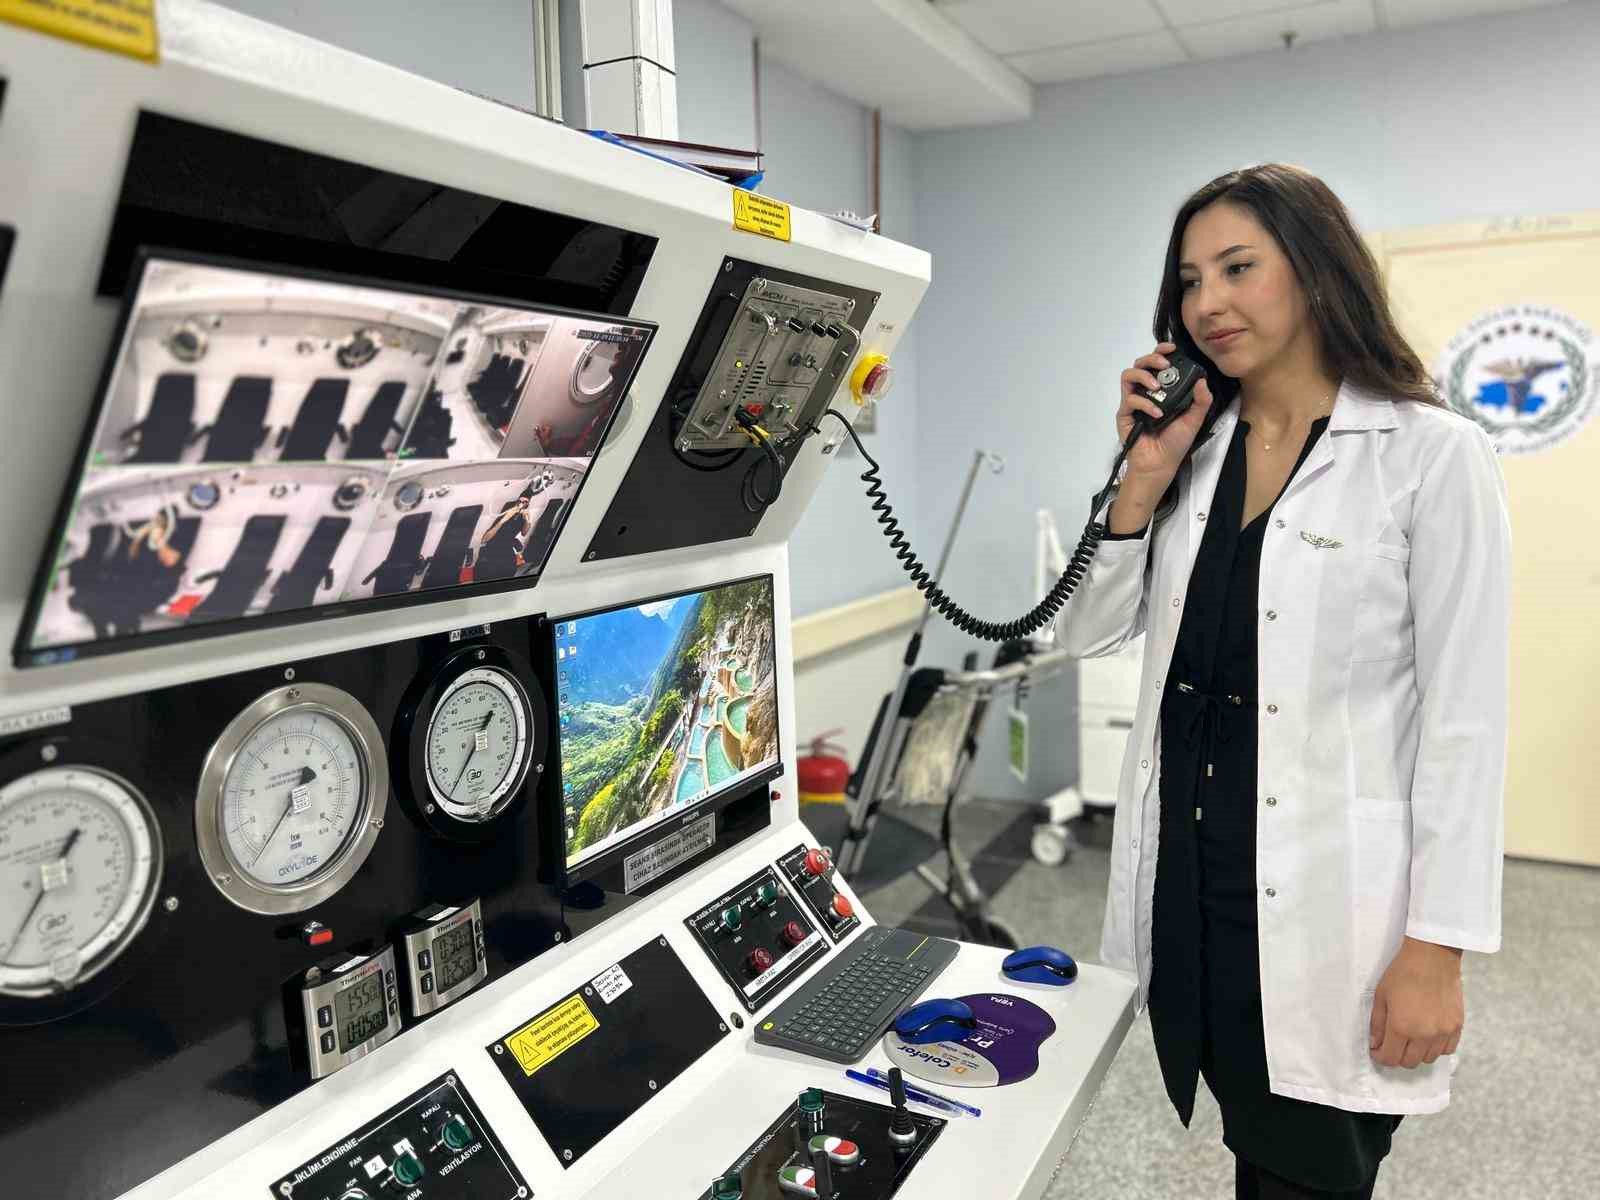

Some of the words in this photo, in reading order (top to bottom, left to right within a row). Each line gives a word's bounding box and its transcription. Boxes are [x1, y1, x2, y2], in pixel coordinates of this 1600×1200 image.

[897, 1045, 951, 1069] Colefor
[421, 1103, 441, 1120] KAPALI
[295, 1137, 359, 1184] İKLİMLENDİRME
